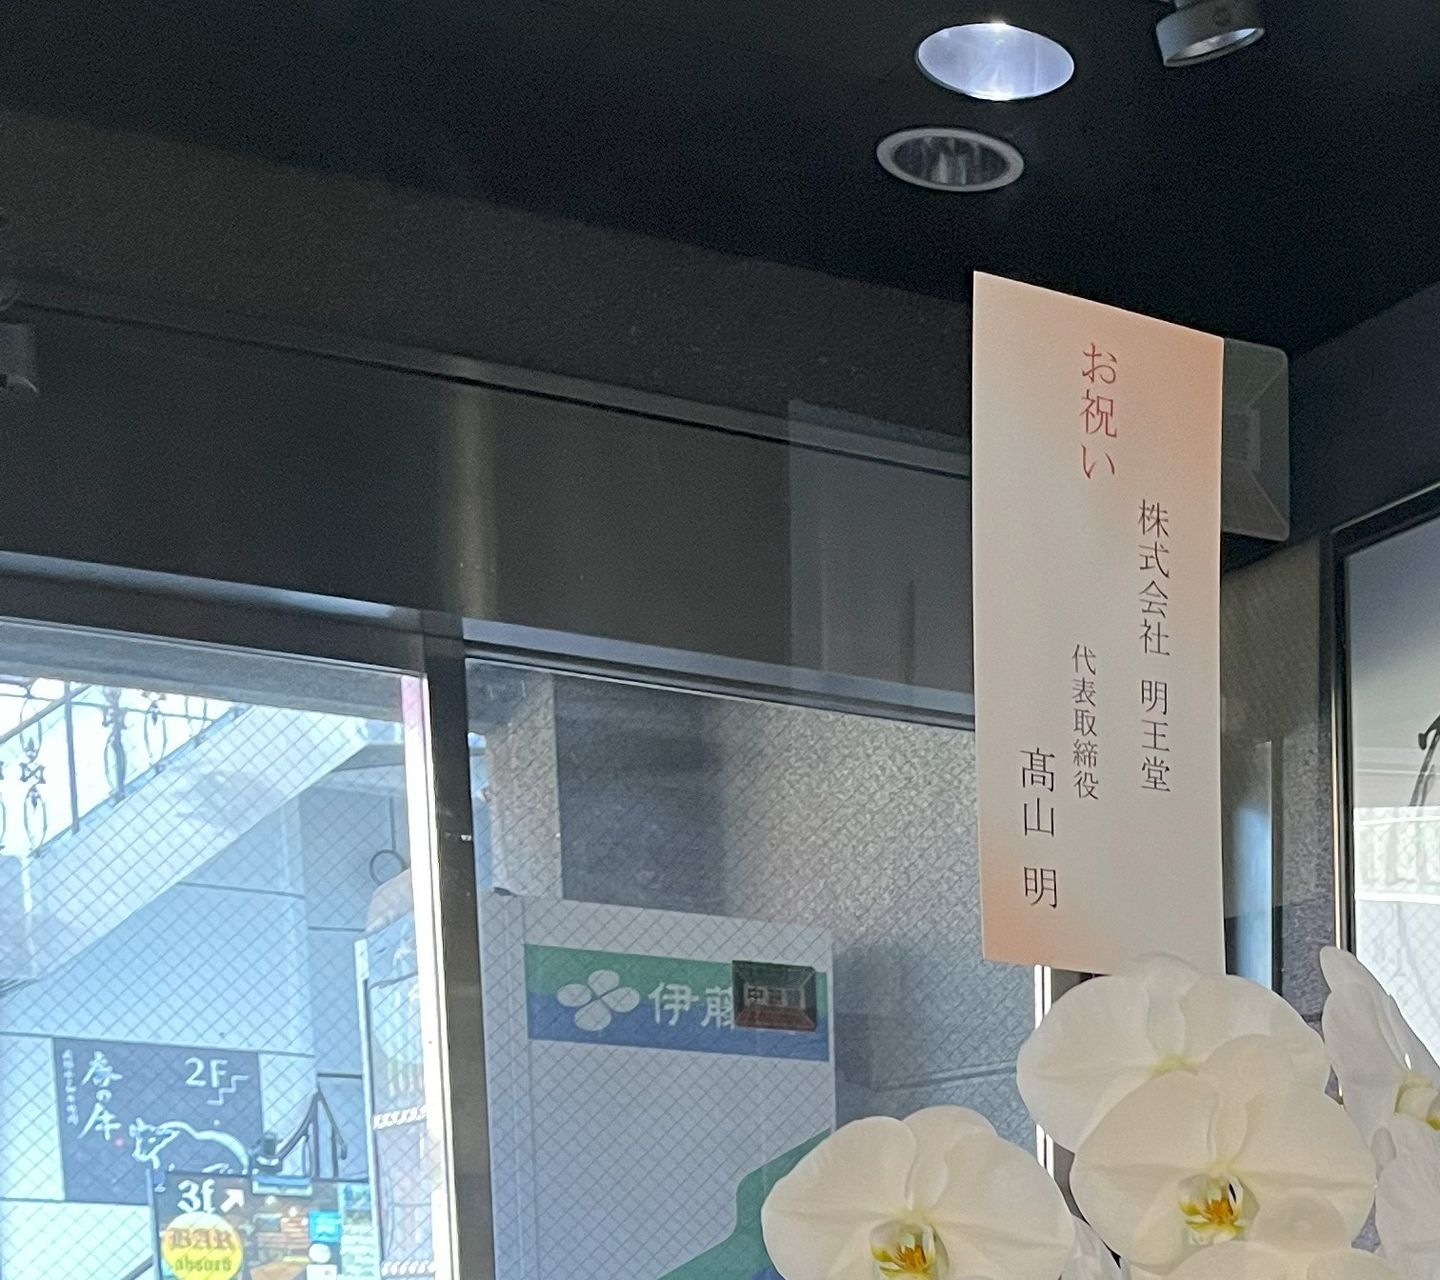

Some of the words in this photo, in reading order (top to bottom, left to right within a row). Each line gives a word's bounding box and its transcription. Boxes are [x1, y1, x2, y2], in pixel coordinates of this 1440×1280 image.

[1080, 342, 1118, 480] お祝い
[1138, 498, 1172, 657] 株式会社
[1072, 643, 1099, 800] 代表取締役
[1140, 678, 1171, 793] 明王堂
[1023, 866, 1058, 909] 明
[184, 1056, 229, 1089] 2F
